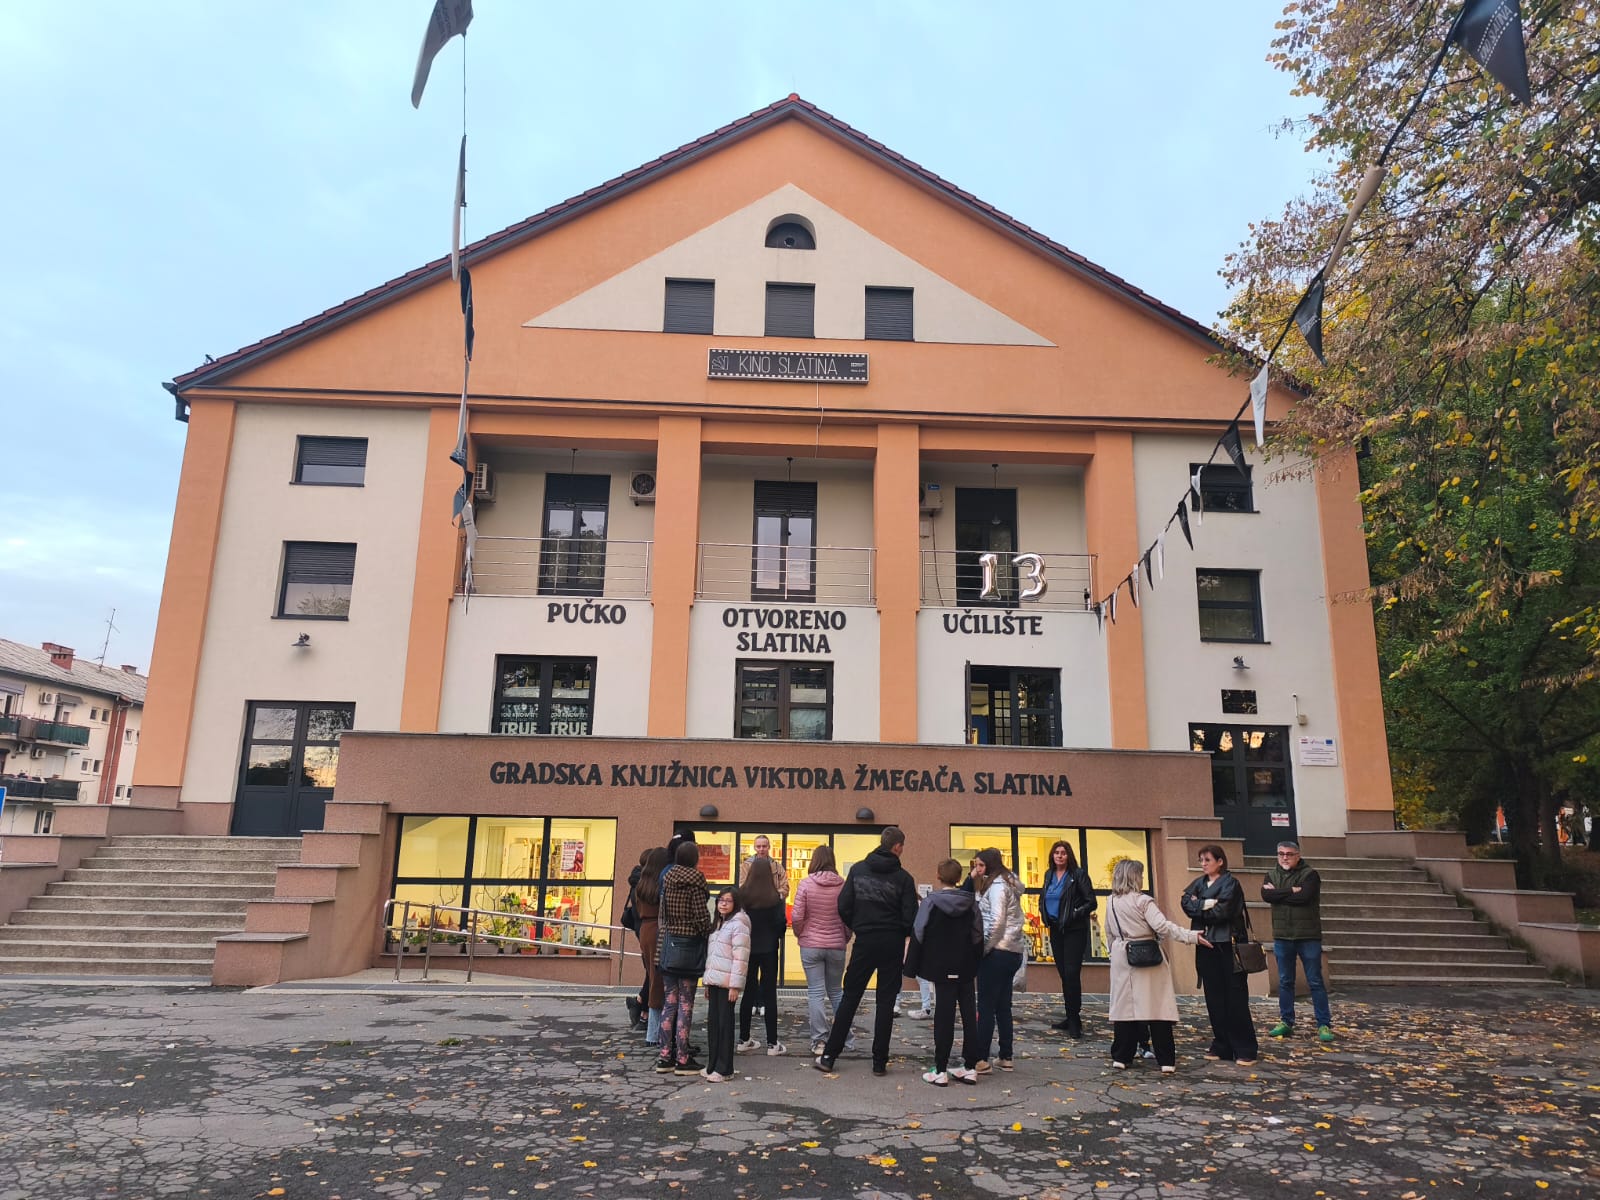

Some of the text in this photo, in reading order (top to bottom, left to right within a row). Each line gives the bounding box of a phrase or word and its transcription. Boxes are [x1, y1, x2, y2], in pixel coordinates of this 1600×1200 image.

[739, 355, 838, 375] KINO SLATINA
[547, 598, 627, 625] PUČKO
[722, 607, 847, 631] OTVORENO
[942, 608, 1044, 636] UČILIŠTE
[736, 631, 832, 654] SLATINA
[500, 722, 538, 735] TRUE
[550, 722, 588, 736] TRUE
[489, 760, 1073, 797] GRADSKA KNJIŽNICA VIKTORA ŽMEGAČA SLATINA
